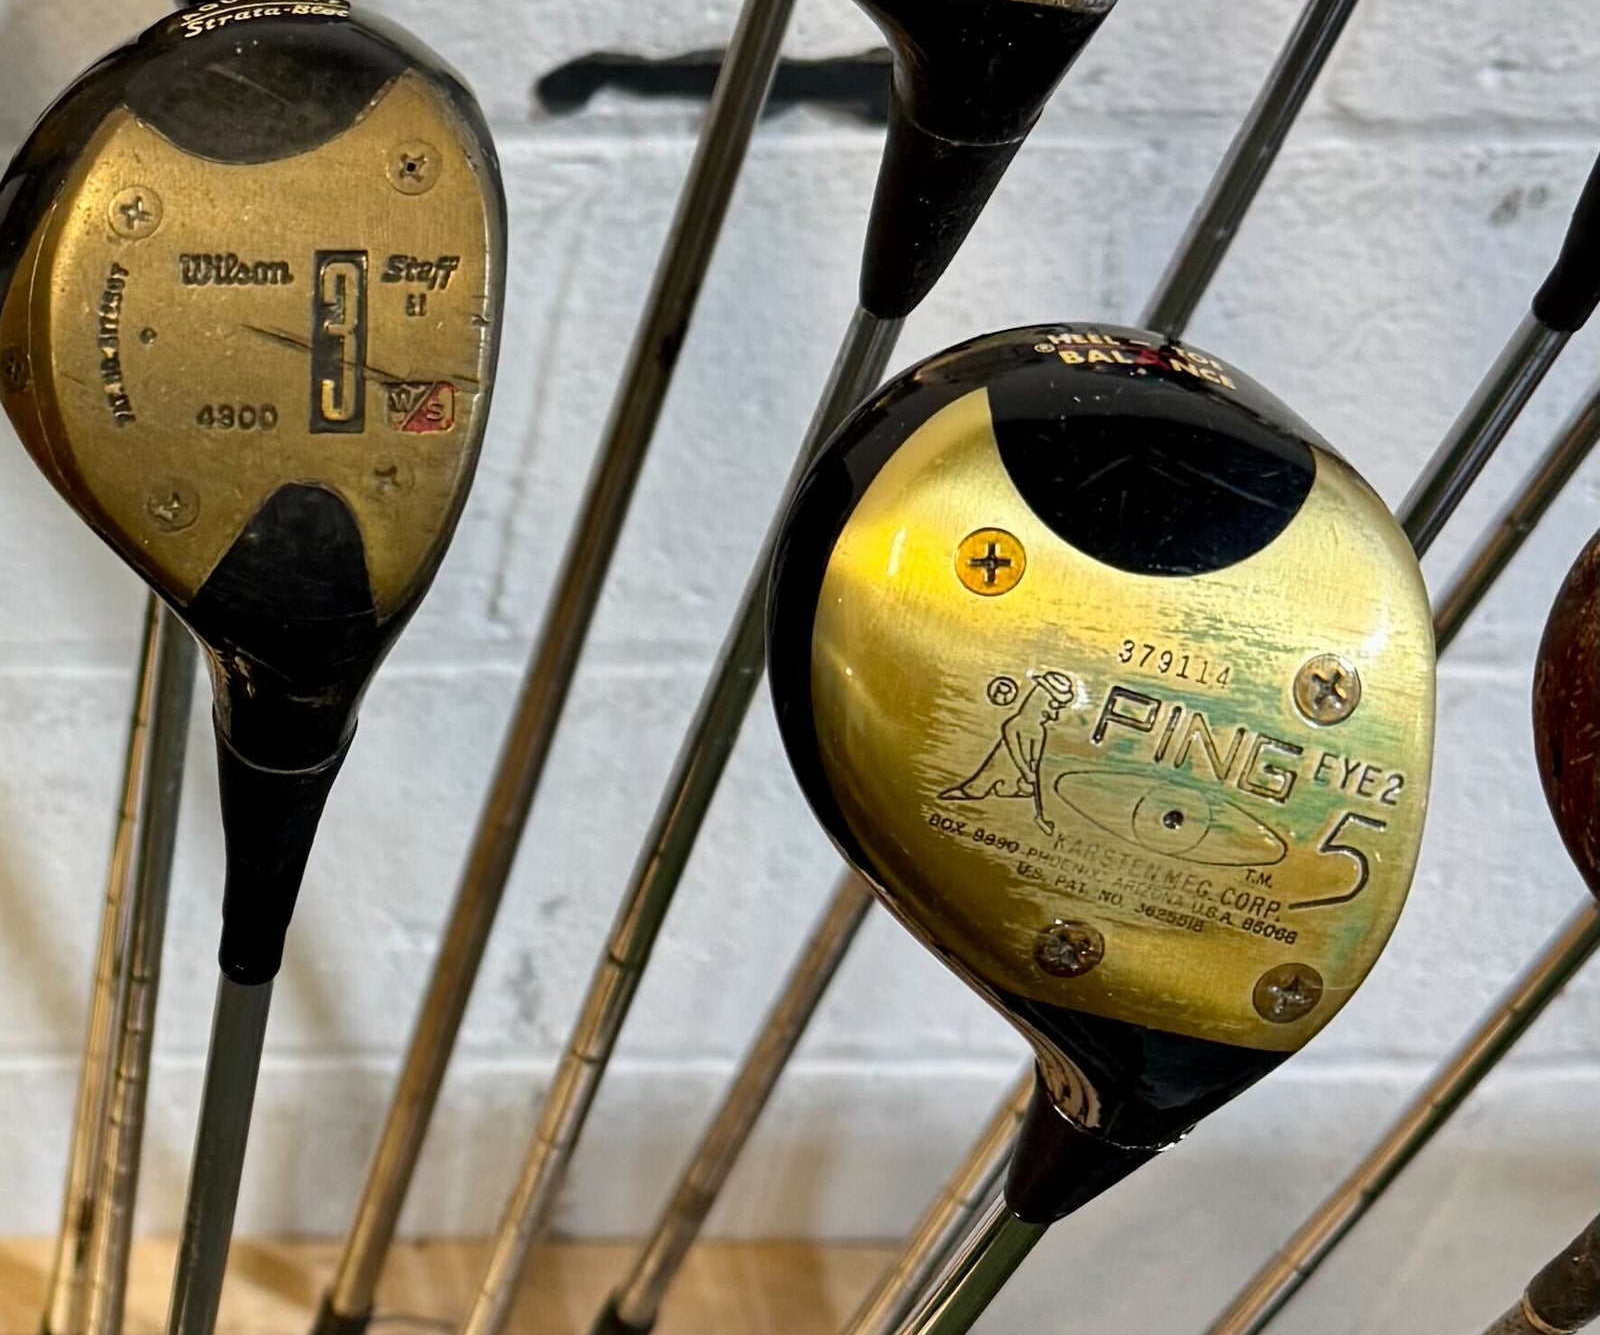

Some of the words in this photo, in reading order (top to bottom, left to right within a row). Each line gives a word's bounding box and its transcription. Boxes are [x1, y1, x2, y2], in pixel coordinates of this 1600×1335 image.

[179, 254, 293, 286] Wilson
[380, 254, 461, 291] Staff
[320, 260, 358, 422] 3
[1047, 333, 1120, 346] HEEL
[1057, 349, 1236, 391] BALANCE
[1118, 639, 1231, 689] 379114
[1090, 685, 1304, 803] PING
[928, 813, 967, 834] BOX
[1052, 833, 1161, 881] KARSTEN
[1220, 887, 1281, 922] CORP.
[1287, 810, 1387, 910] 5
